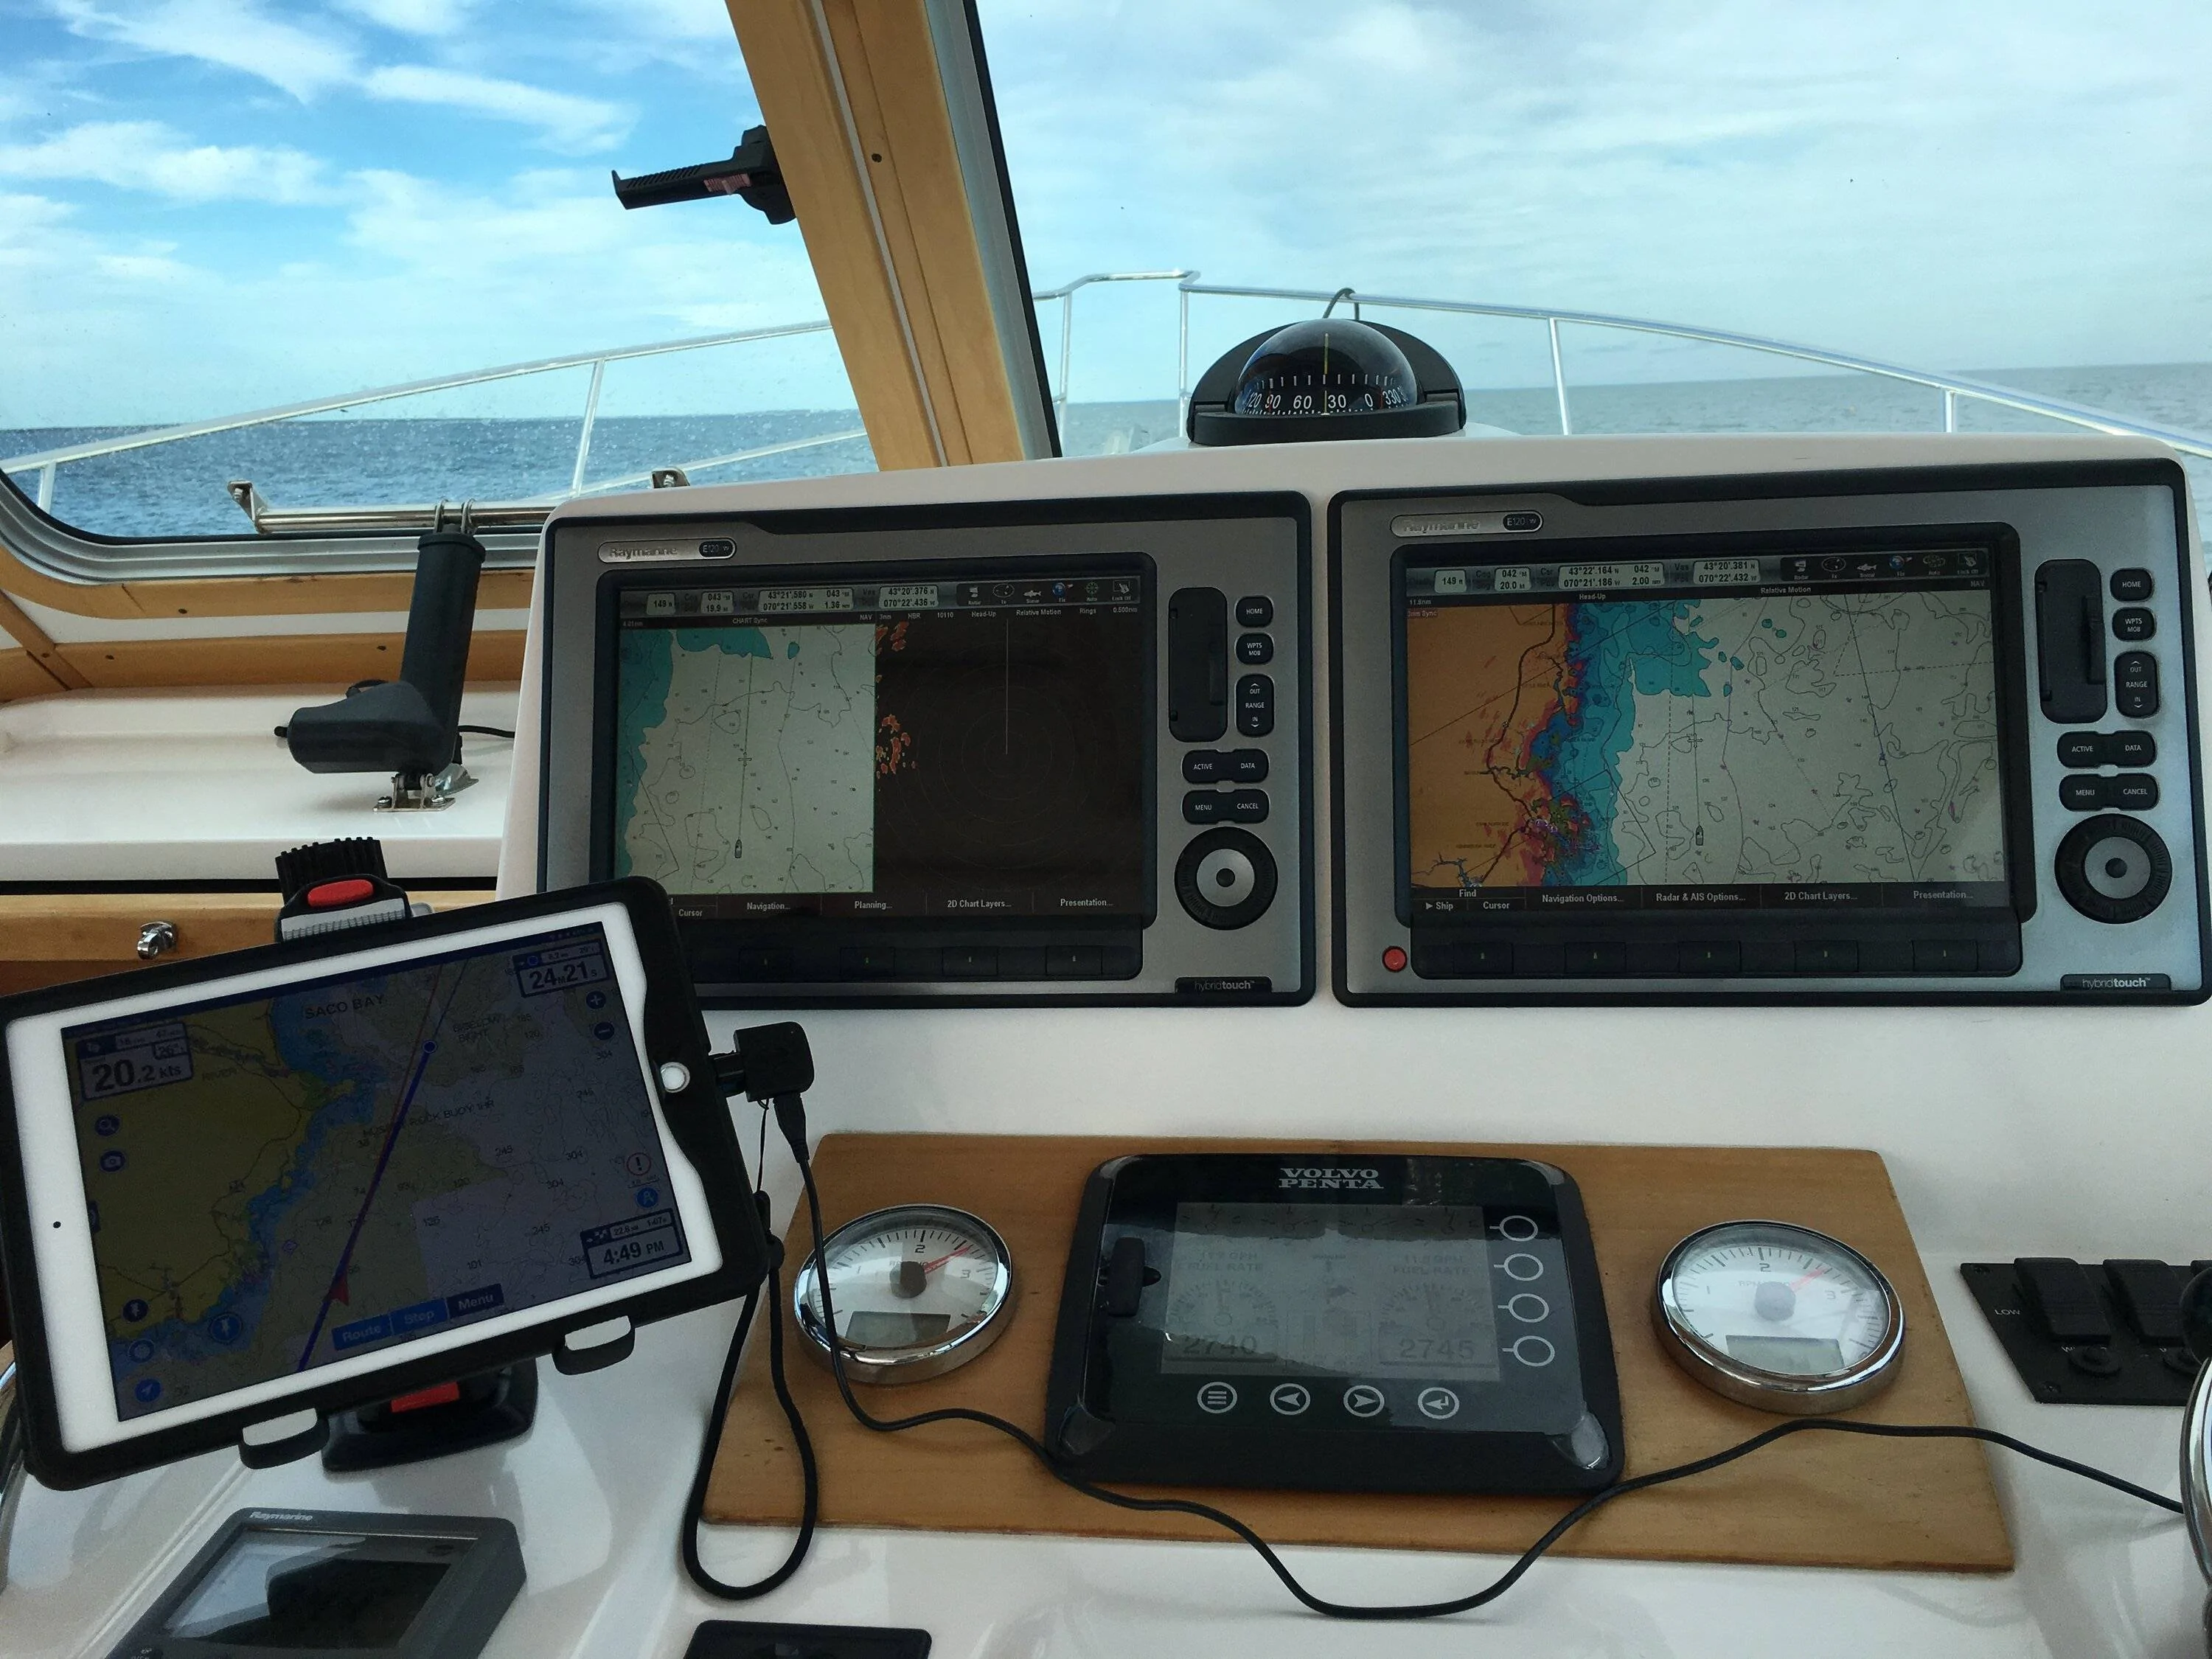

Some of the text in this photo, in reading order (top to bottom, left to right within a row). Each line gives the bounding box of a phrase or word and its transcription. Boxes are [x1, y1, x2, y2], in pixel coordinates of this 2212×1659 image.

[1265, 394, 1281, 409] 90
[1293, 395, 1312, 409] 60
[1328, 394, 1346, 408] 30
[1365, 393, 1374, 408] 0
[1382, 390, 1399, 405] 330
[1502, 569, 1517, 577] 042
[1500, 582, 1517, 590] 20.0
[1632, 577, 1649, 585] 2.00
[1579, 593, 1606, 601] Head-Up
[971, 611, 997, 619] Head-Up
[1016, 608, 1040, 616] Relative
[1079, 607, 1096, 615] Rings
[1459, 889, 1477, 898] Find
[1655, 893, 1680, 902] Radar
[1682, 893, 1689, 901] &
[1690, 893, 1705, 901] AIS
[1784, 892, 1796, 900] 2D
[1798, 891, 1822, 900] Chart
[947, 900, 958, 908] 2D
[959, 900, 980, 908] Chart
[1542, 894, 1585, 905] Navigation
[1436, 902, 1454, 911] Ship
[1483, 901, 1510, 910] Cursor
[678, 908, 703, 917] Cursor
[305, 993, 384, 1019] SACO BAY
[443, 1103, 473, 1119] BUOY
[1279, 1168, 1379, 1179] VOLVO
[1278, 1178, 1385, 1189] PENTA
[604, 1240, 664, 1265] 4:49 PM
[914, 1245, 926, 1253] 2
[960, 1270, 971, 1279] 3
[1759, 1262, 1772, 1273] 2
[1824, 1290, 1836, 1300] 3
[458, 1294, 493, 1310] Menu
[403, 1309, 435, 1326] Stop
[342, 1324, 382, 1343] Route
[1183, 1335, 1259, 1356] 2740
[1399, 1339, 1475, 1360] 2745
